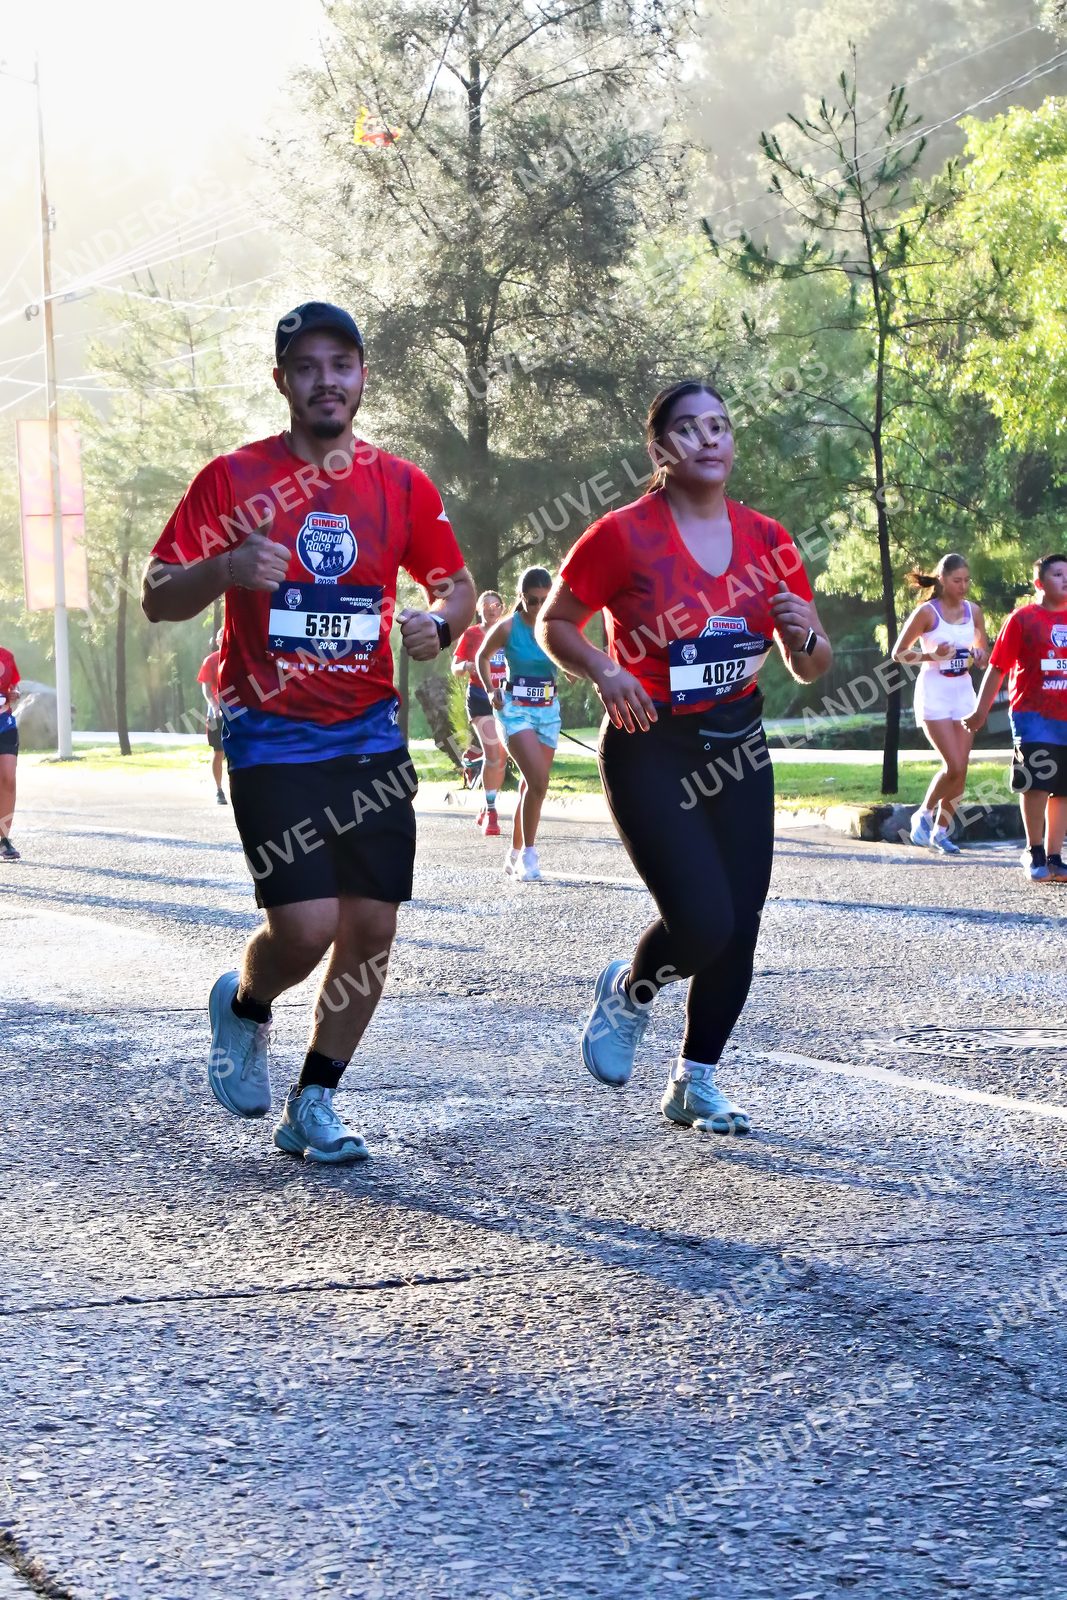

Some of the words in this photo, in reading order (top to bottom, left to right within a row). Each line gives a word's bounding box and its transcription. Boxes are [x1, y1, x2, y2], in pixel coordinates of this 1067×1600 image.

[312, 518, 344, 529] BIMBO
[312, 531, 343, 544] Global
[306, 541, 331, 552] Race
[305, 614, 351, 638] 5367
[712, 621, 743, 630] BIMBO
[702, 660, 746, 686] 4022
[526, 688, 545, 696] 5618
